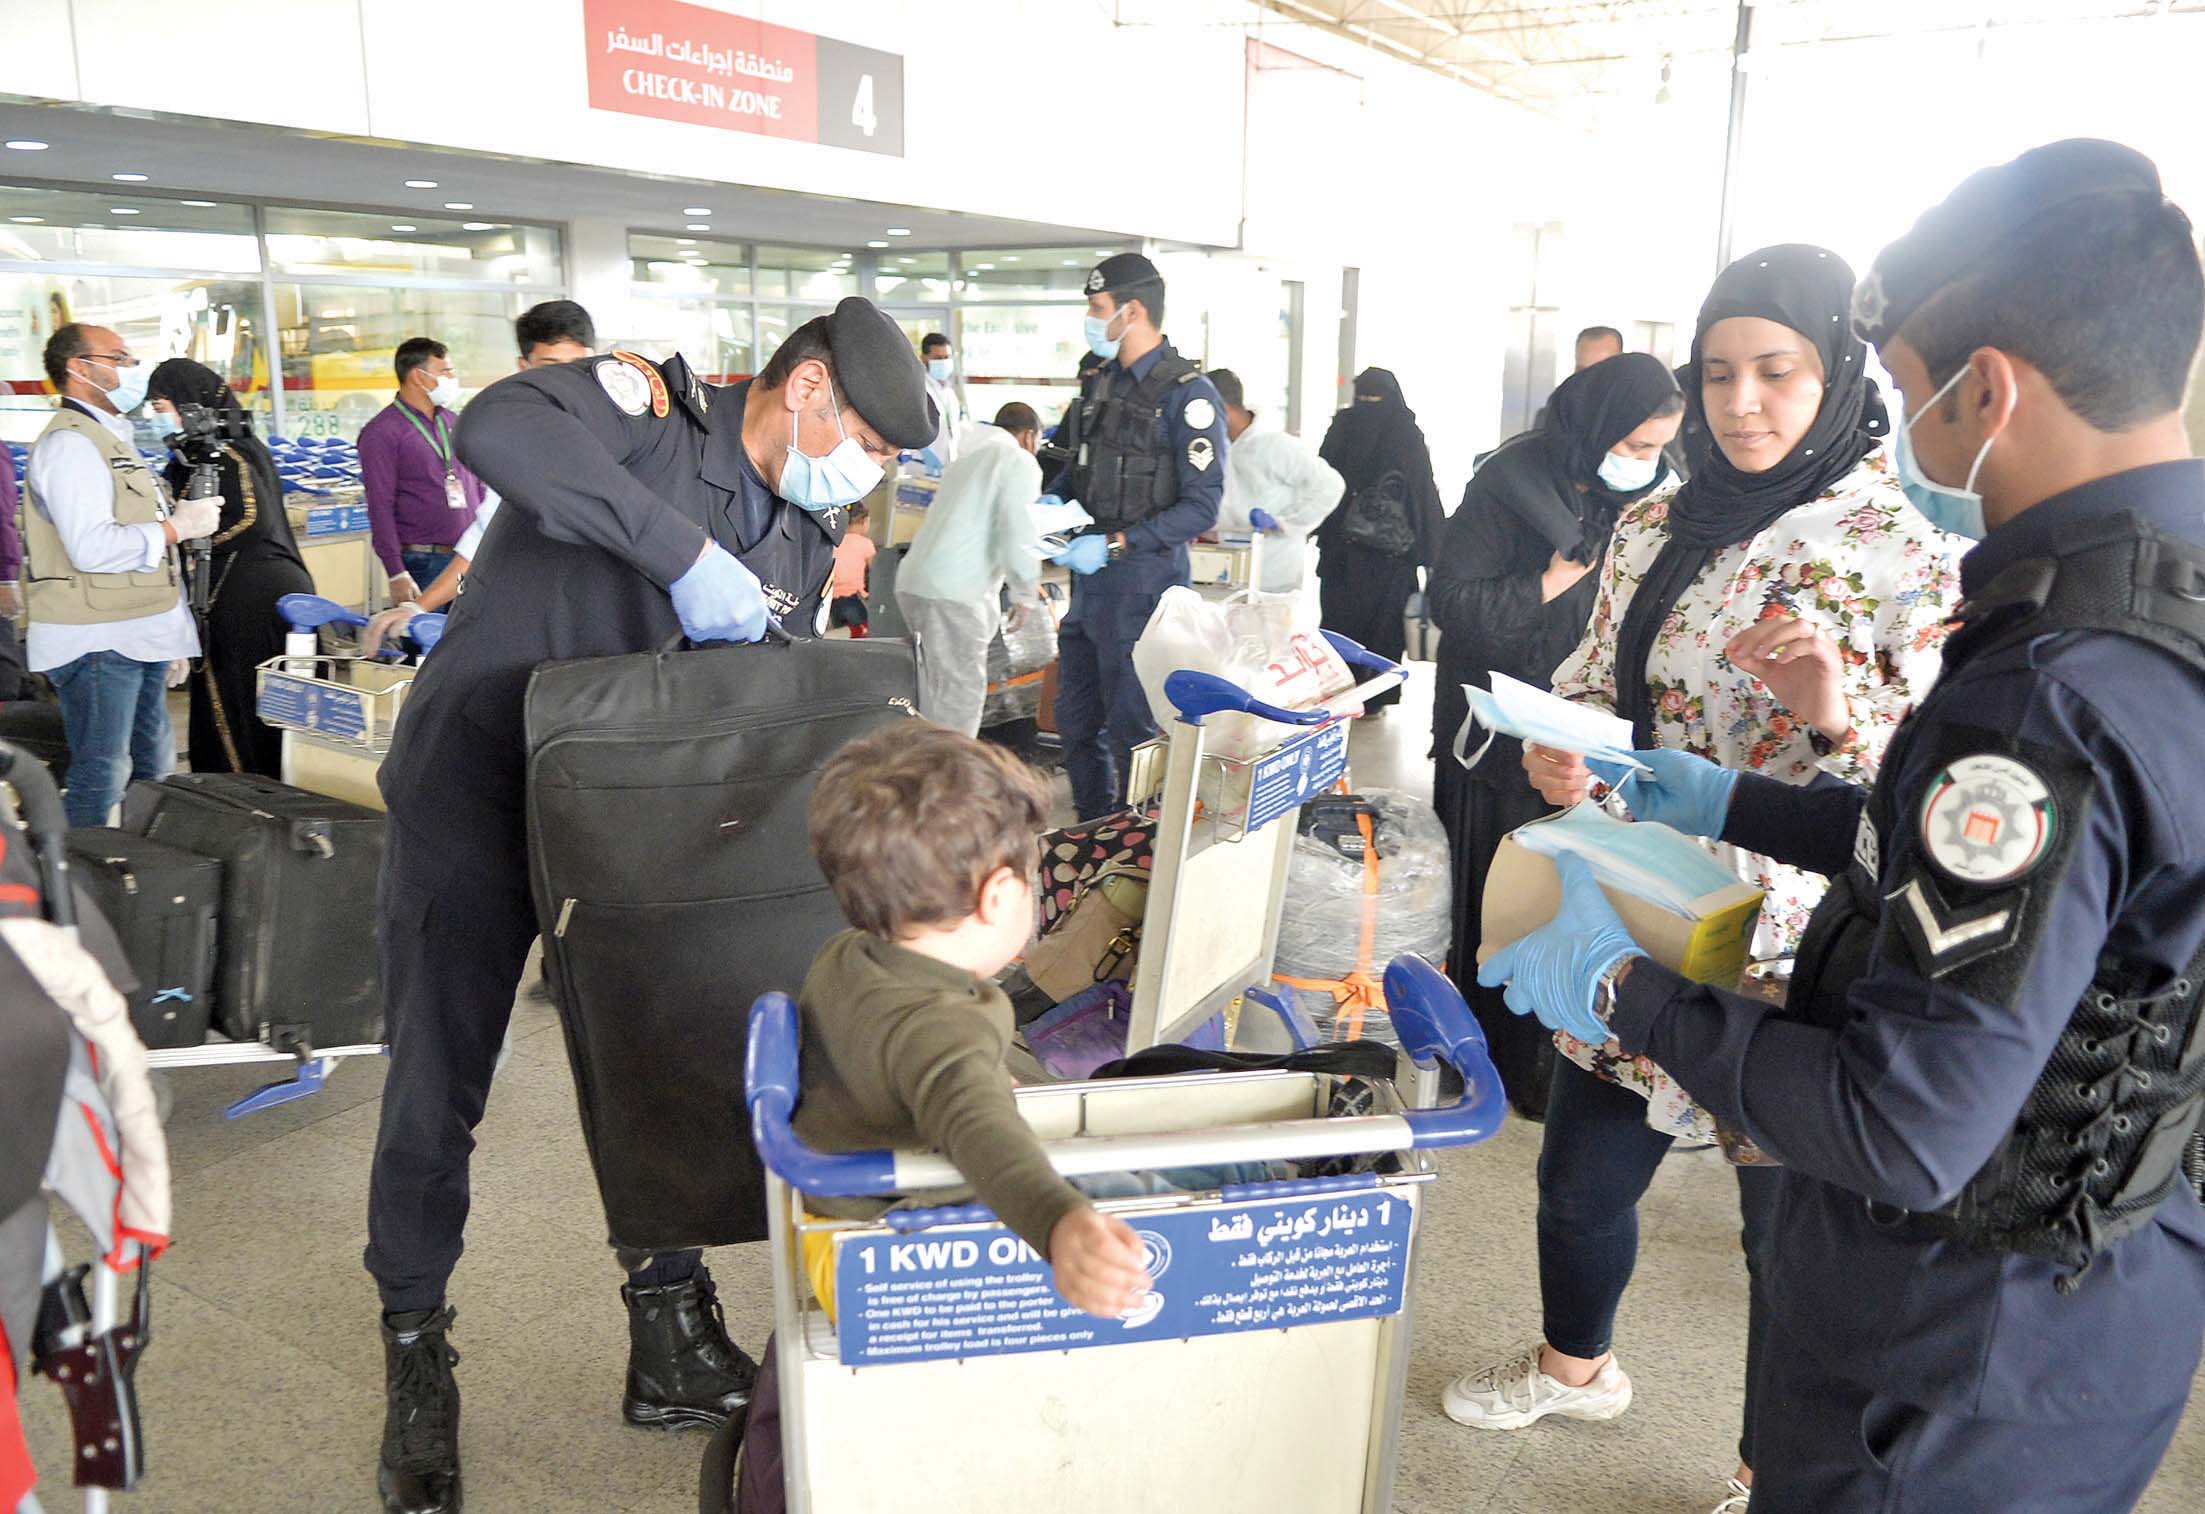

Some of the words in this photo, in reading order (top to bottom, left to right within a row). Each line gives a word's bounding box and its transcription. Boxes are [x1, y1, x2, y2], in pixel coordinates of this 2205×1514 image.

[606, 26, 663, 56] السفر
[735, 51, 794, 83] منطقة
[622, 69, 725, 110] CHECK-IN
[728, 88, 783, 120] ZONE
[852, 74, 877, 136] 4
[1208, 1213, 1253, 1242] فقط
[1257, 1206, 1318, 1247] كويتي
[1317, 1203, 1369, 1236] دينار
[1377, 1200, 1391, 1226] 1
[859, 1246, 875, 1274] 1
[890, 1240, 979, 1272] KWD
[988, 1236, 1042, 1265] ON
[890, 1280, 932, 1291] service
[934, 1278, 948, 1288] of
[949, 1277, 983, 1288] using
[984, 1275, 1004, 1285] the
[1006, 1272, 1043, 1283] trolley
[998, 1300, 1017, 1309] the
[1068, 1329, 1094, 1341] only
